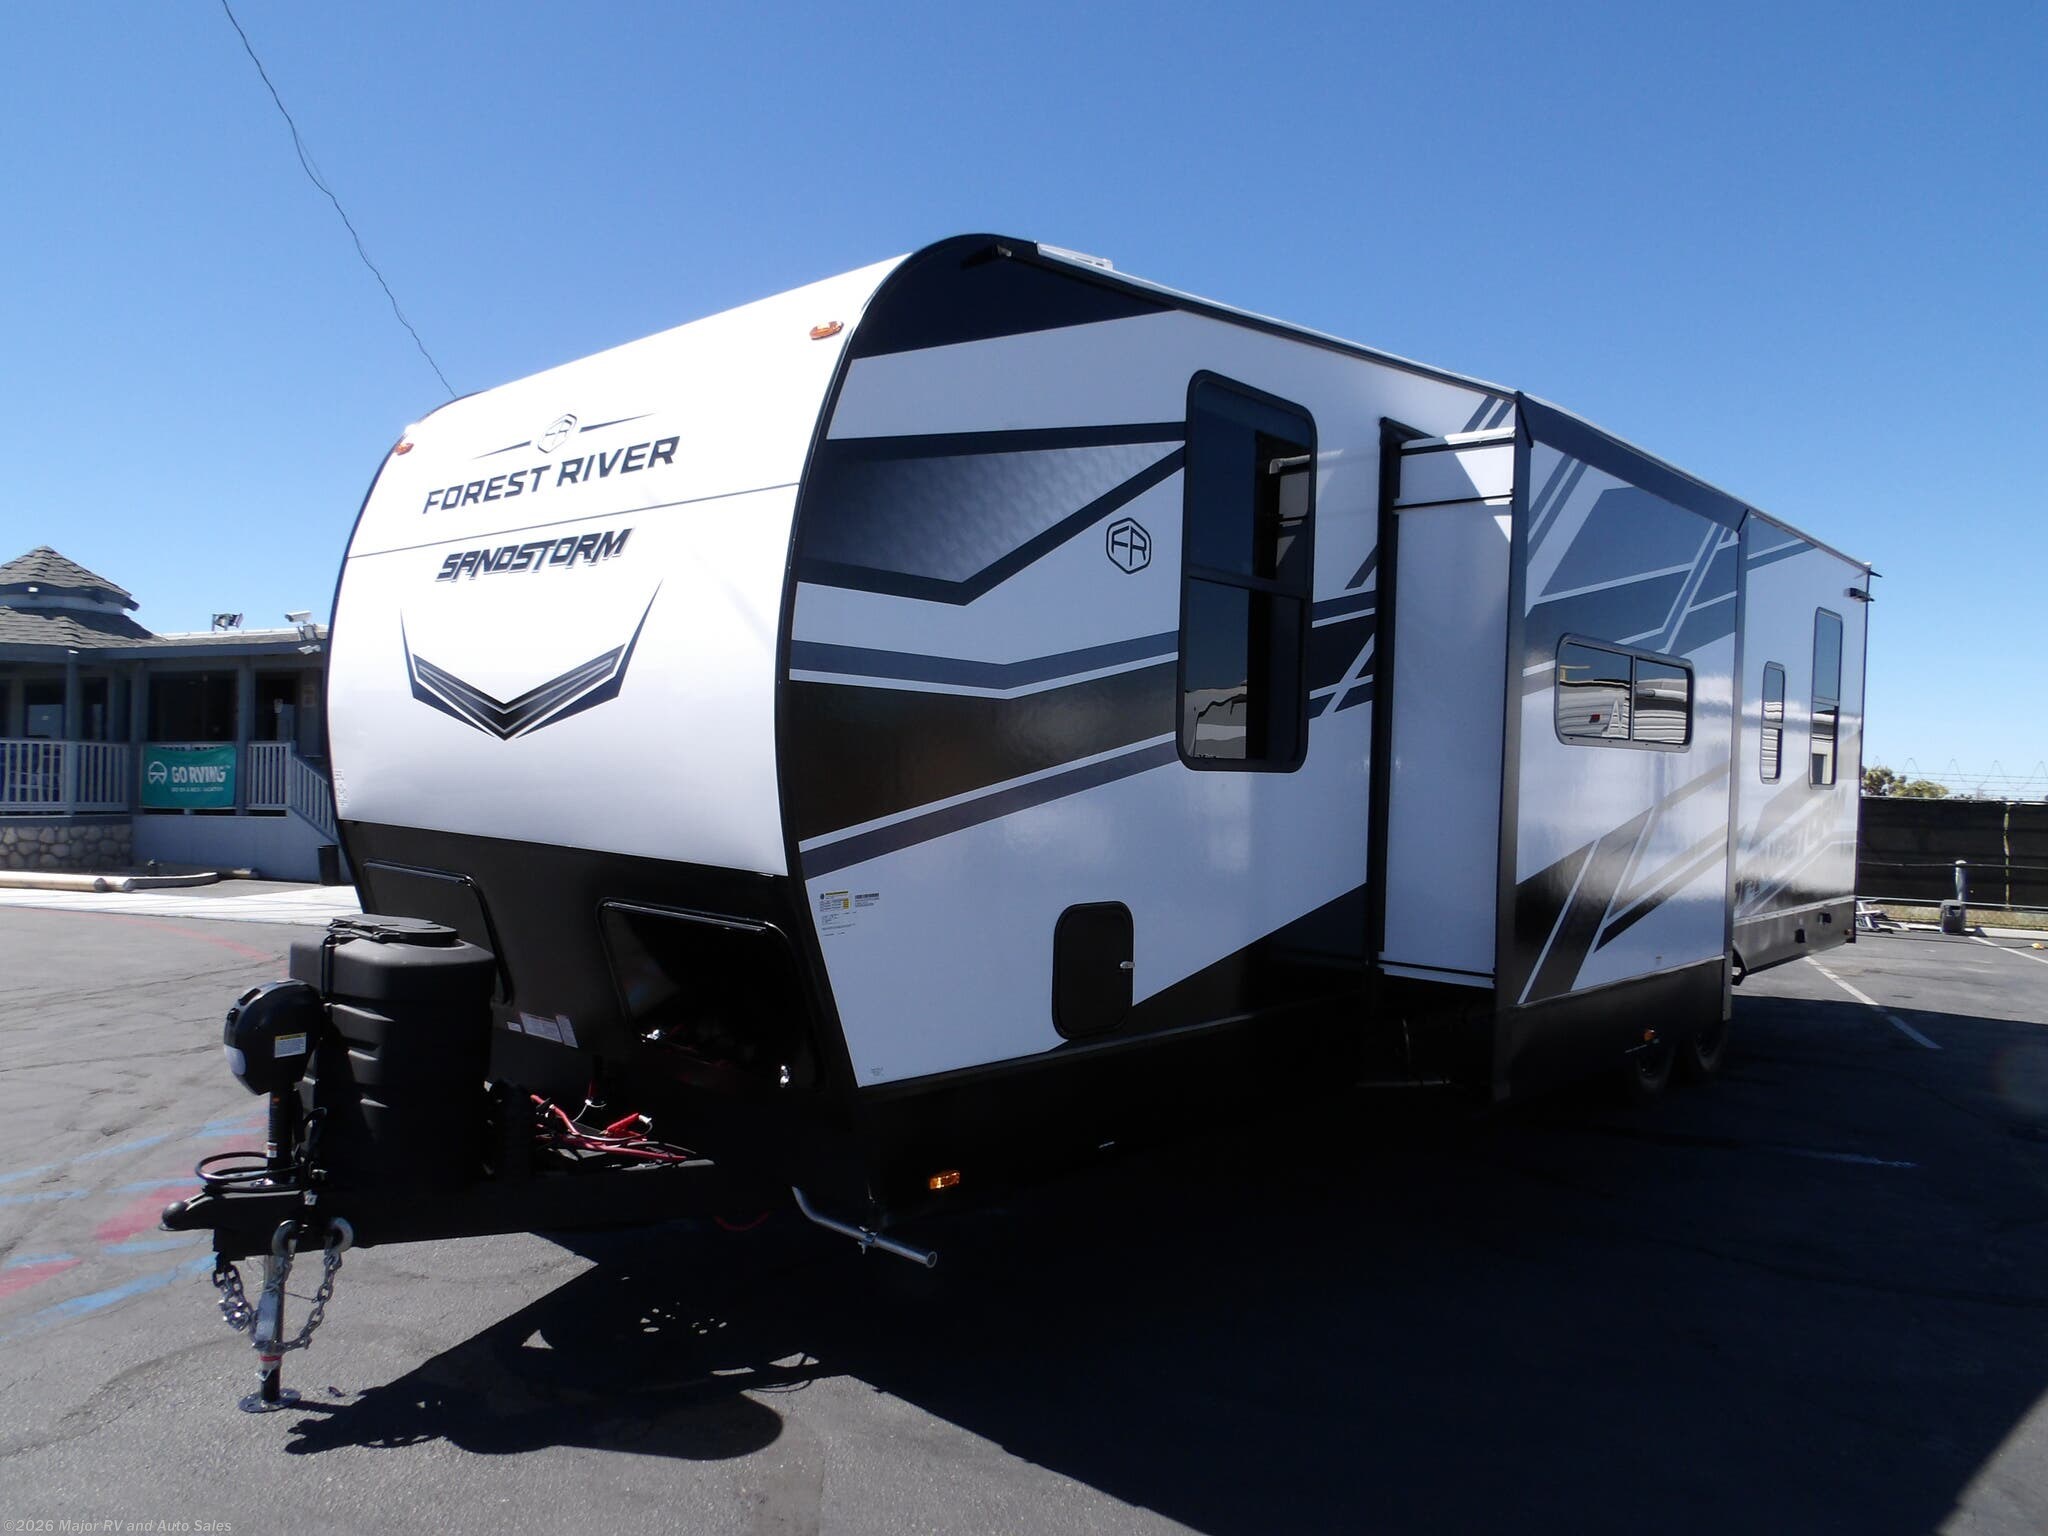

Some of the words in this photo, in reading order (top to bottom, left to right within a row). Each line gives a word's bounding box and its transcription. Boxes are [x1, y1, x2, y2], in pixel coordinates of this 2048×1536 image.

[422, 464, 552, 514] FOREST
[556, 435, 681, 487] RIVER
[435, 527, 634, 582] SANDSTORM
[171, 766, 188, 783] GO
